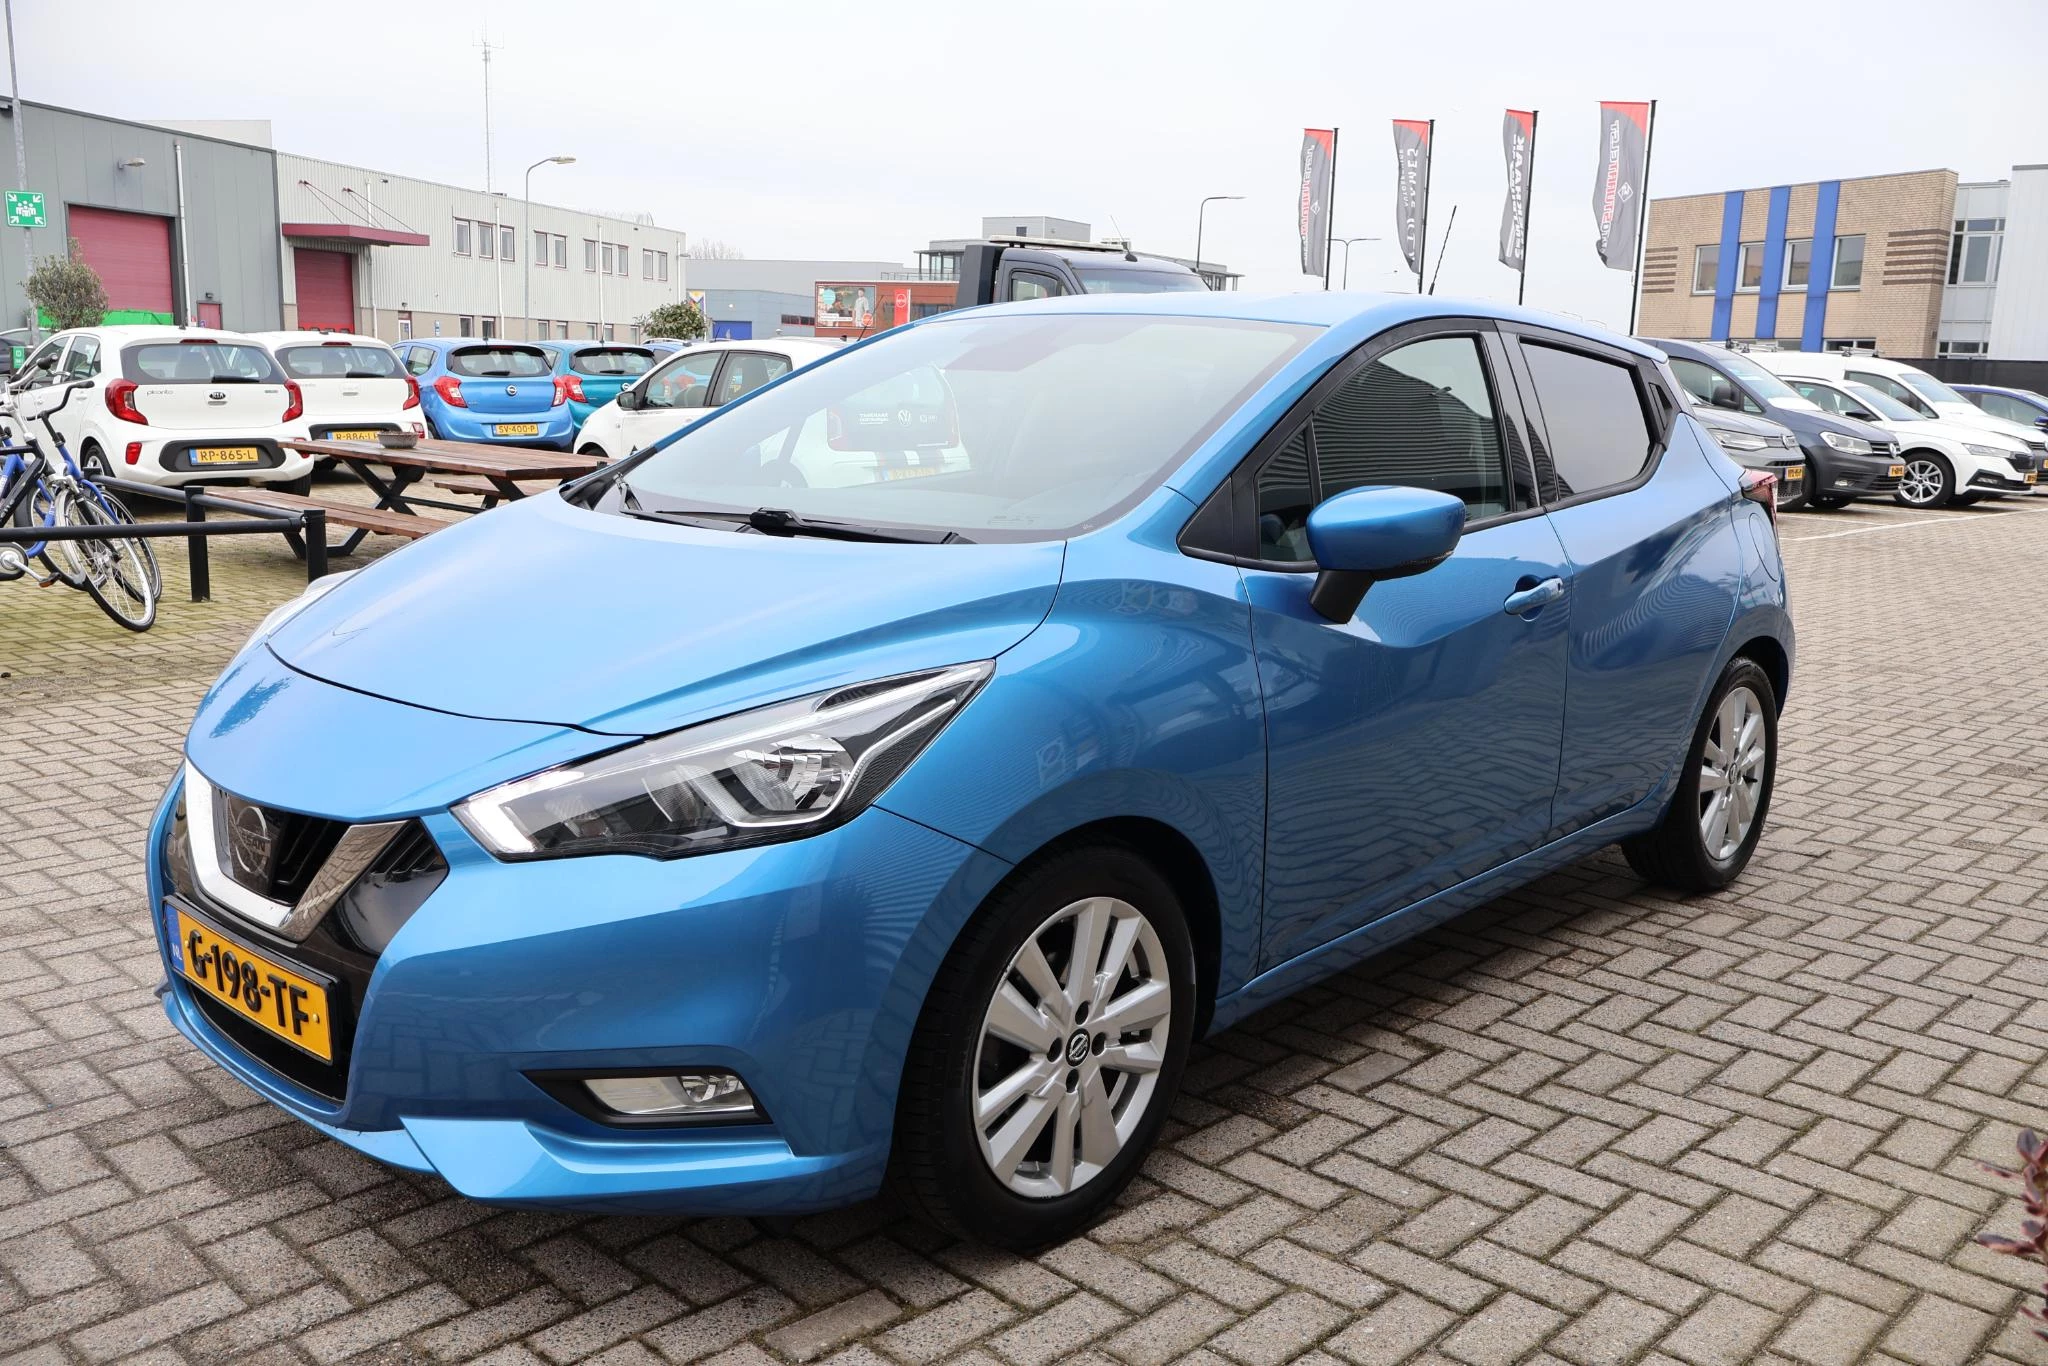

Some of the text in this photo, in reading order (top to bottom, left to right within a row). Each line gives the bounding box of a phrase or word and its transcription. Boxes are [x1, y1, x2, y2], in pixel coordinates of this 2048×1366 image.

[210, 391, 226, 400] KIA
[498, 424, 536, 434] SV-400-P
[200, 449, 254, 461] RP-865-L
[171, 929, 310, 1036] NL G-198-TF
